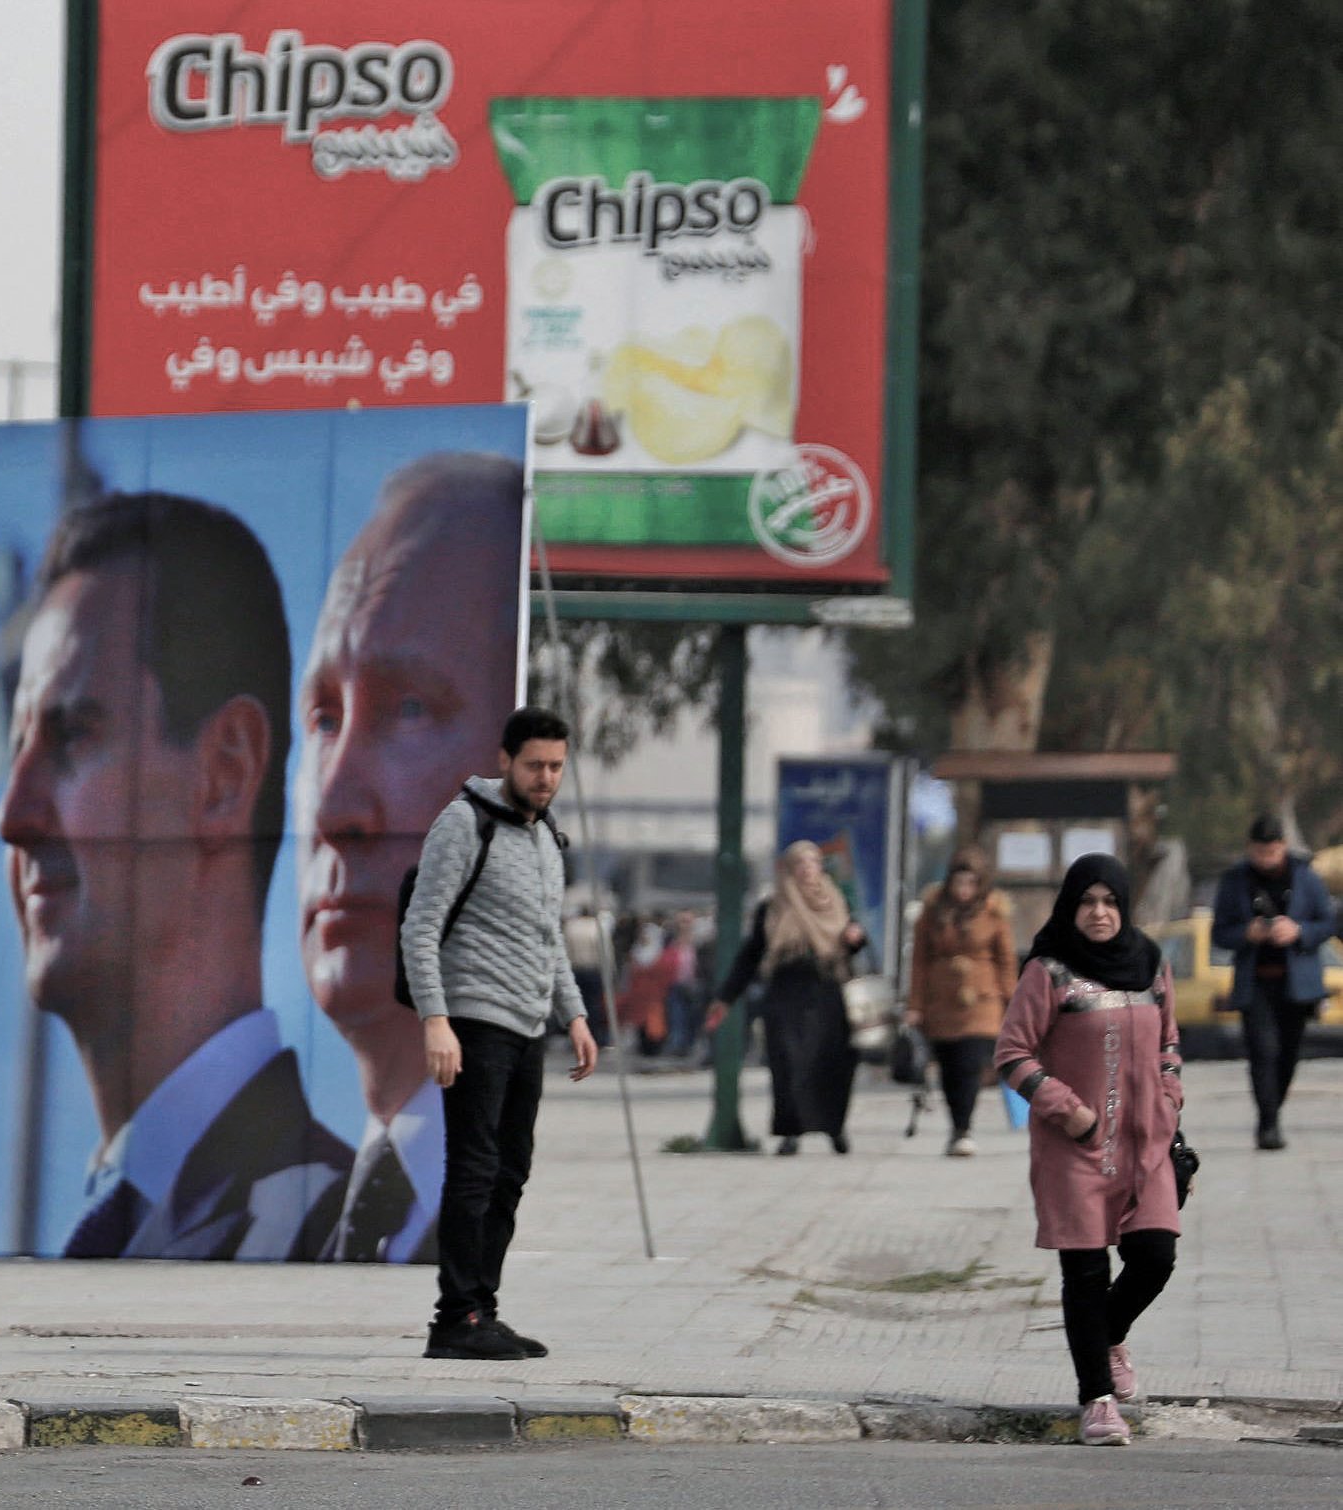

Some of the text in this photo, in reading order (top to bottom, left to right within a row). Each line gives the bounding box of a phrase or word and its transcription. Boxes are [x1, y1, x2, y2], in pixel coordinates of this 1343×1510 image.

[147, 31, 452, 142] Chipso
[541, 172, 770, 256] Chipso
[138, 264, 483, 328] في طيب وفي أطيب
[165, 334, 455, 395] وفي شيبس وفي
